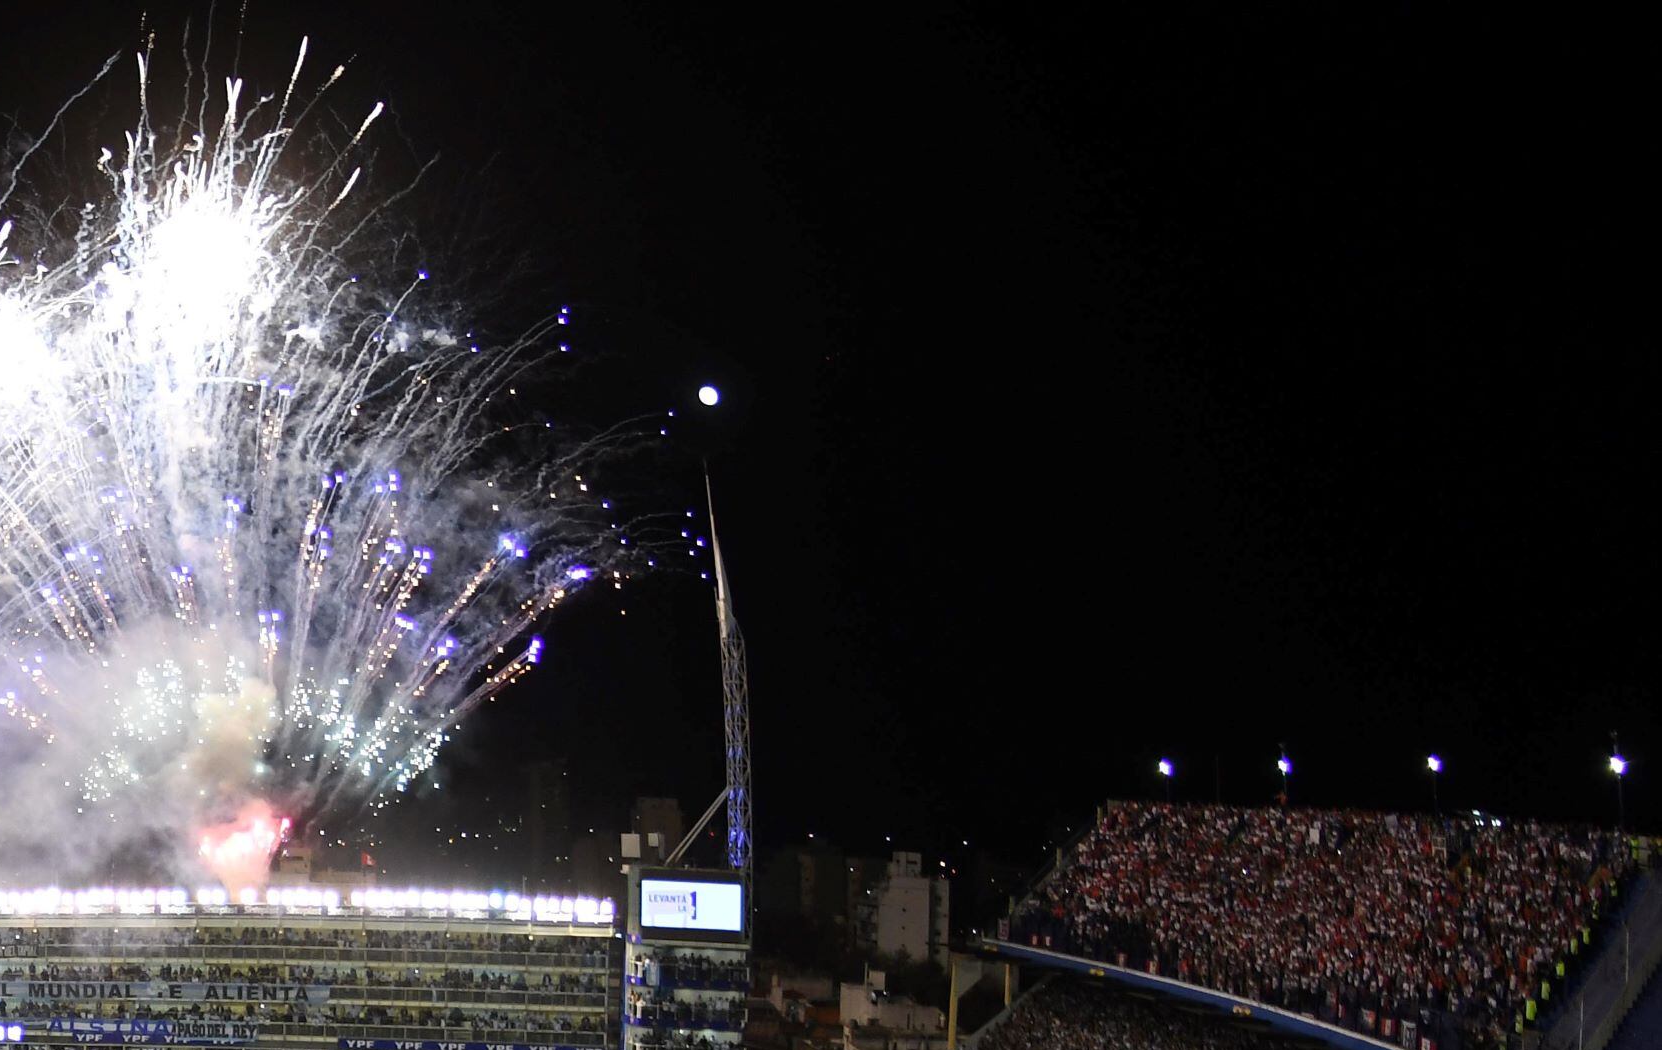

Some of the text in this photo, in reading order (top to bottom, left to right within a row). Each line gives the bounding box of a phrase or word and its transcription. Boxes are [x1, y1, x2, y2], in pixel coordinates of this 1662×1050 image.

[28, 984, 137, 999] MUNDIAL
[205, 985, 309, 1001] ALIENTA
[50, 1014, 170, 1036] ALSINA
[208, 1022, 230, 1039] DEL
[232, 1023, 258, 1039] REY
[76, 1033, 103, 1042] YPF
[346, 1040, 374, 1049] YPF
